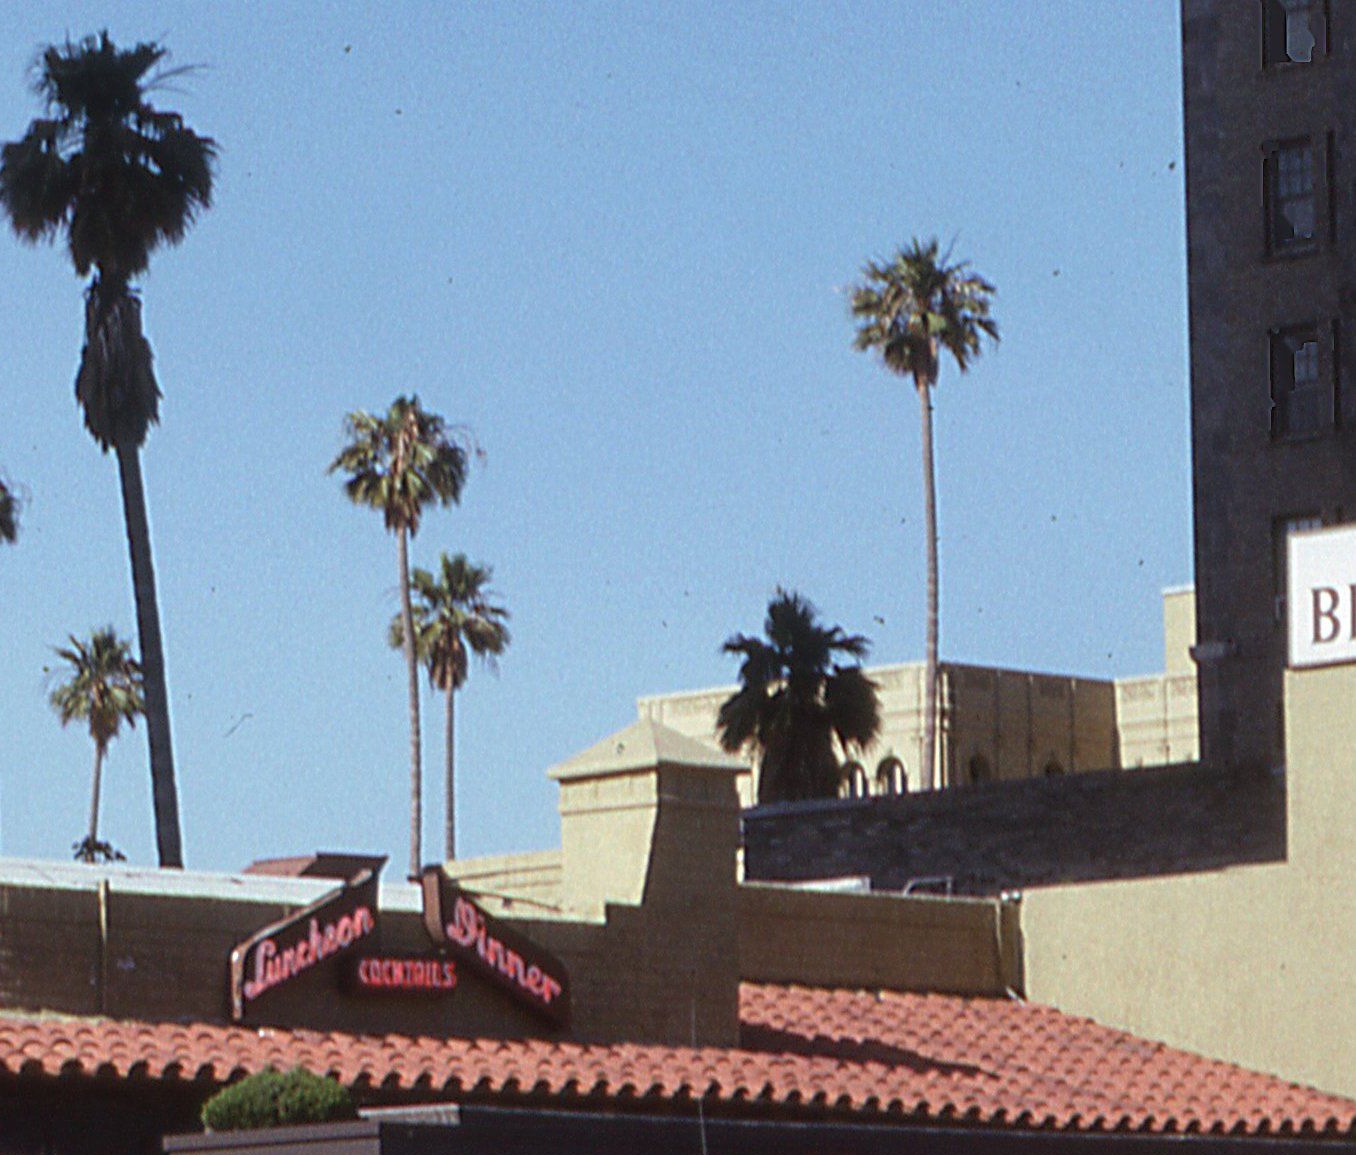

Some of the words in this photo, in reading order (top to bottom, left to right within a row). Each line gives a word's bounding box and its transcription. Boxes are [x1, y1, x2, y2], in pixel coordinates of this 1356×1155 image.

[243, 905, 375, 999] Luncheon
[357, 958, 457, 990] COCKTAILS
[445, 896, 562, 1003] Dinner
